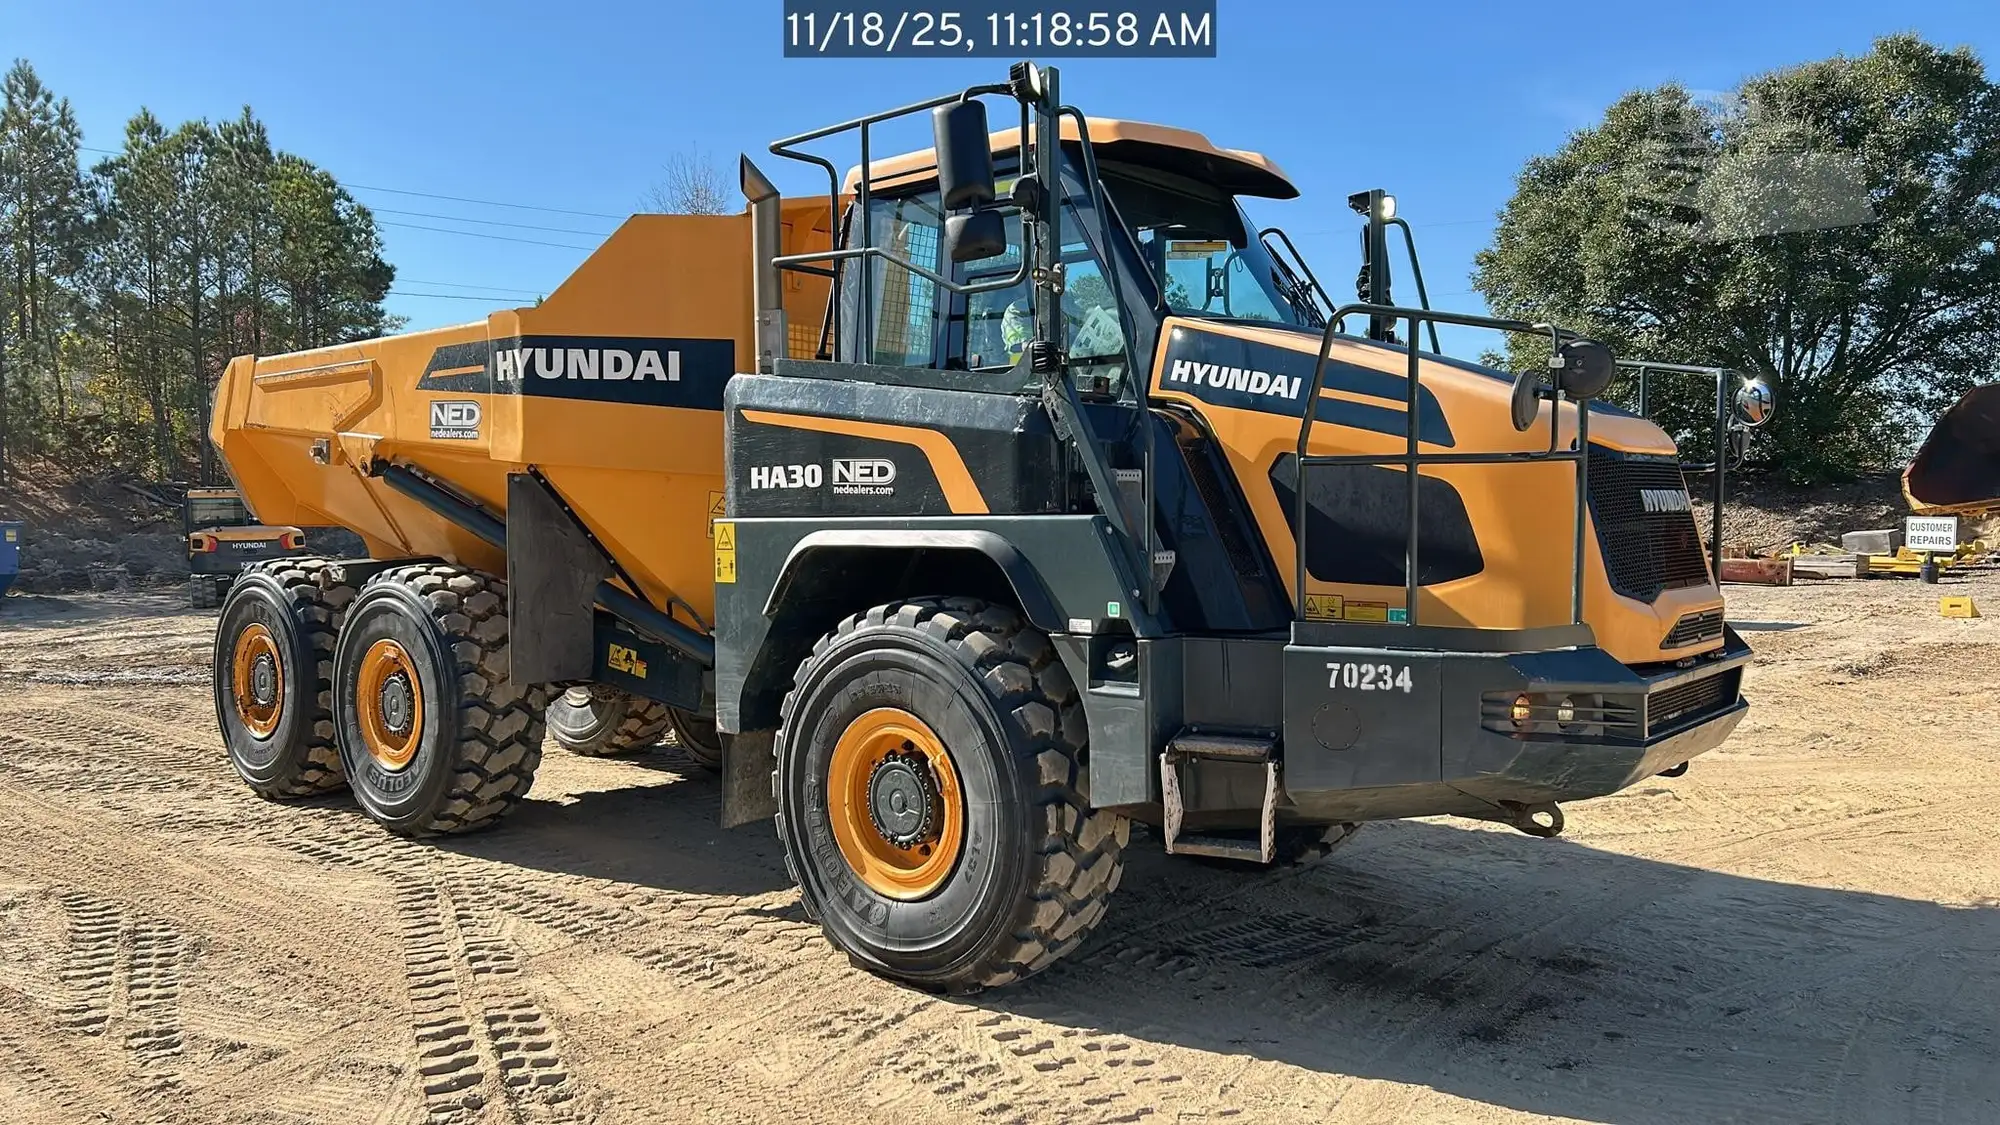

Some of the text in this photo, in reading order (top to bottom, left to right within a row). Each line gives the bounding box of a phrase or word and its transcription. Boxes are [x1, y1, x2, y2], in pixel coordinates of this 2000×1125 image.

[496, 347, 681, 382] HYUNDAI
[1170, 359, 1302, 400] HYUNDAI
[430, 401, 481, 428] NED
[430, 428, 478, 438] nedealers.com
[750, 464, 823, 490] HA30
[832, 458, 897, 486] NED
[833, 483, 894, 495] nedealers.com
[1640, 489, 1690, 512] HYUNDAI
[1909, 522, 1953, 533] CUSTOMER
[1909, 535, 1952, 546] REPAIRS
[1326, 662, 1413, 693] 70234
